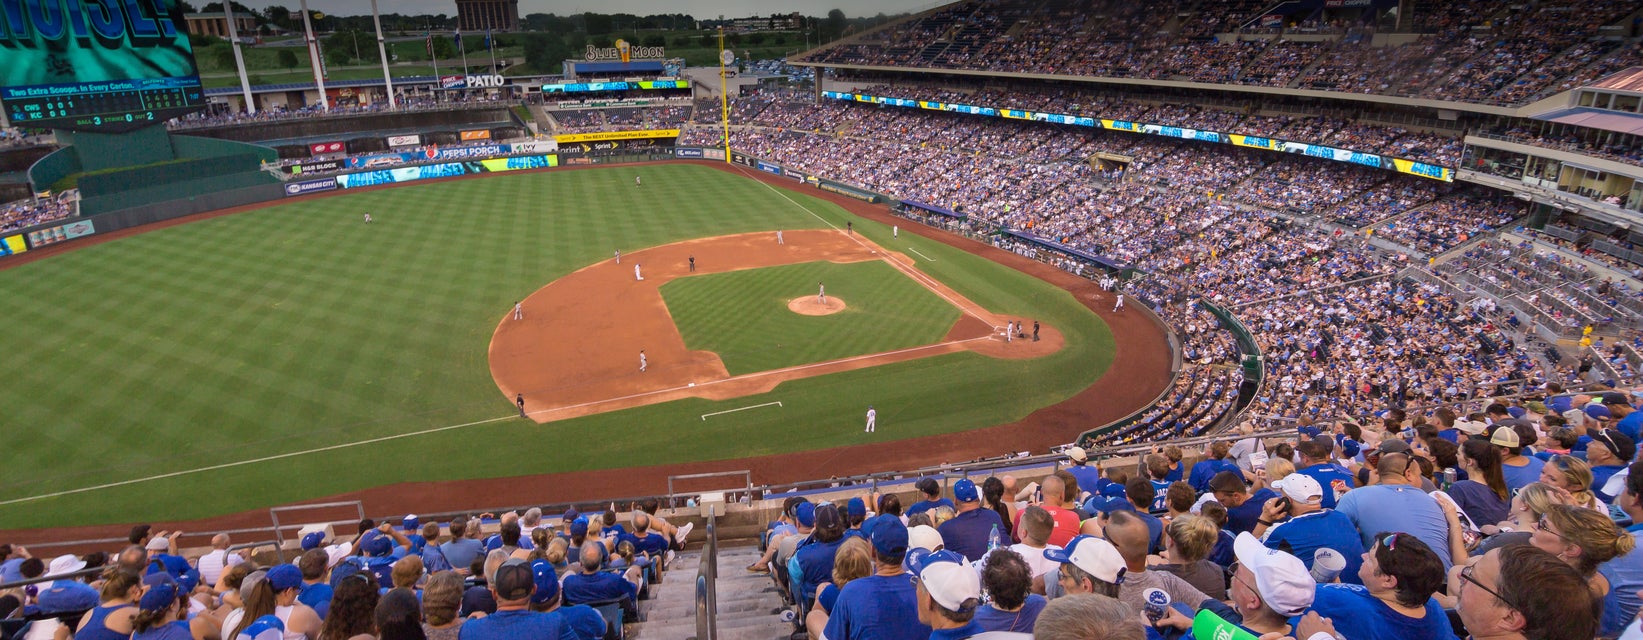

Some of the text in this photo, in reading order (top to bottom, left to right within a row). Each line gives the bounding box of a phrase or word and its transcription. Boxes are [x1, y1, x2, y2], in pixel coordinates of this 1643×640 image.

[585, 45, 665, 61] BLUE MOON
[467, 74, 505, 87] PATIO
[9, 89, 27, 97] Two
[27, 88, 49, 96] Extra
[49, 86, 80, 94] Scoops.
[88, 84, 109, 92] Every
[93, 116, 101, 125] 3
[125, 113, 133, 122] 0
[146, 112, 154, 120] 2
[443, 146, 500, 158] PEPSI PORCH
[316, 162, 337, 170] BLOCK
[301, 182, 322, 191] KANSAS
